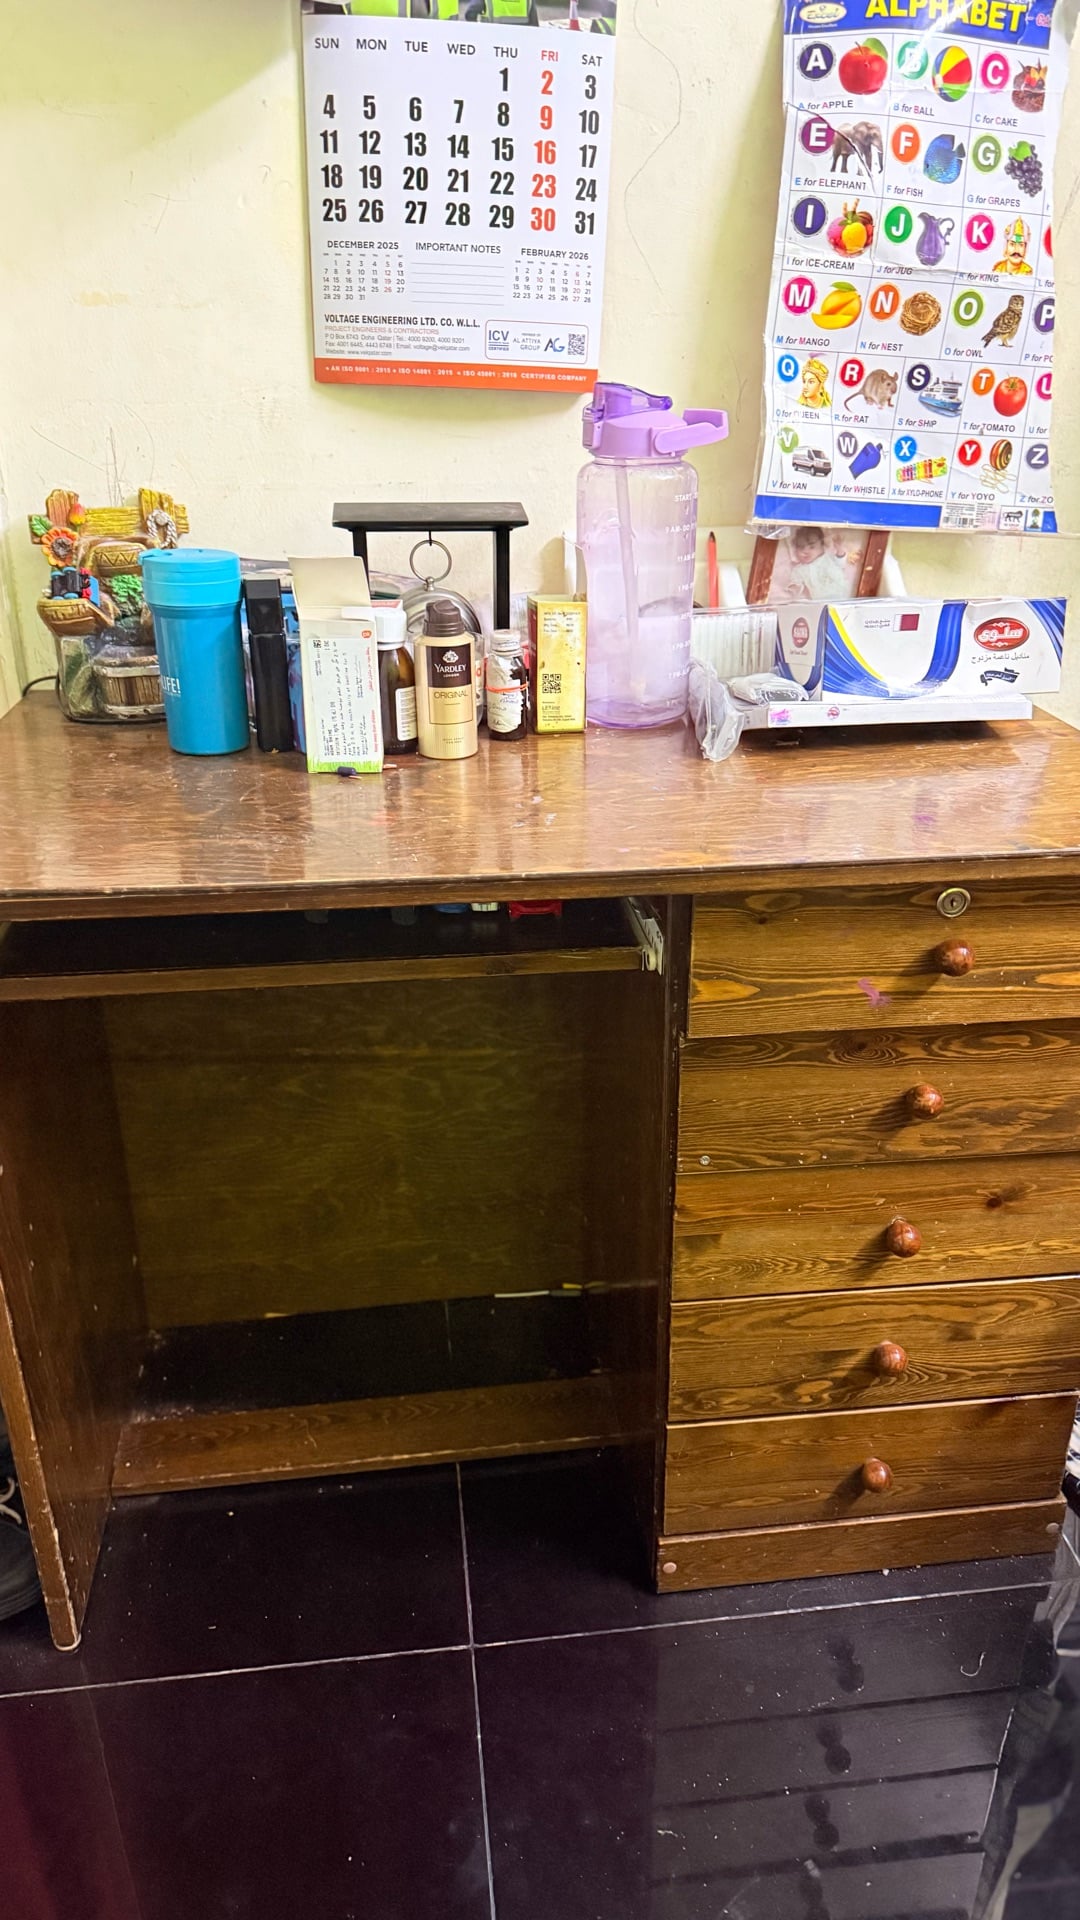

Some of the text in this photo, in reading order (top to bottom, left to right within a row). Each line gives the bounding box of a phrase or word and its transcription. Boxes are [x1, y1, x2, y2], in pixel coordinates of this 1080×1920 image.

[865, 0, 1027, 32] ALPHABET
[314, 38, 602, 67] SUN MON TUE WED THU FRI SAT
[805, 49, 827, 72] A
[986, 61, 1004, 84] C
[499, 68, 596, 100] 1 2 3
[822, 100, 853, 108] APPLE
[901, 105, 912, 113] for
[914, 106, 935, 116] BALL
[323, 94, 599, 135] 4 5 6 7 8 9 10
[975, 114, 1017, 126] C for CAKE
[809, 123, 827, 147] E
[900, 132, 914, 154] F
[320, 130, 597, 168] 11 12 13 14 15 16 17
[977, 142, 996, 165] G
[321, 164, 597, 202] 18 19 20 21 22 23 24
[803, 178, 817, 186] for
[818, 179, 866, 190] ELEPHANT
[906, 187, 923, 197] FISH
[988, 197, 1020, 207] GRAPES
[322, 199, 594, 235] 25 26 27 28 29 30 31
[805, 205, 814, 228] I
[892, 214, 905, 236] J
[971, 221, 990, 244] K
[415, 242, 501, 254] IMPORTANT NOTES
[521, 248, 589, 260] FEBRUARY 2026
[792, 257, 804, 265] for
[805, 259, 855, 270] ICE-CREAM
[896, 267, 913, 275] JUG
[979, 274, 999, 282] KING
[788, 284, 811, 307] M
[874, 292, 893, 313] N
[959, 297, 977, 319] O
[1039, 304, 1055, 325] P
[325, 314, 359, 323] VOLTAGE
[362, 315, 418, 325] ENGINEERING
[420, 318, 438, 326] LTD.
[457, 319, 480, 327] W.L.L.
[488, 330, 509, 341] ICV
[785, 336, 797, 344] for
[799, 337, 830, 346] MANGO
[860, 341, 866, 349] N
[881, 343, 903, 351] NEST
[965, 349, 983, 358] OWL
[781, 358, 795, 377] Q
[844, 363, 859, 382] R
[912, 368, 925, 387] S
[977, 373, 991, 391] T
[841, 414, 852, 422] for
[982, 424, 1015, 432] TOMATO
[1036, 426, 1048, 434] for
[780, 431, 795, 448] V
[838, 436, 856, 454] W
[899, 440, 912, 457] X
[964, 444, 977, 461] Y
[1031, 449, 1046, 464] Z
[779, 481, 791, 489] for
[792, 482, 807, 490] VAN
[854, 486, 886, 494] WHISTLE
[971, 493, 995, 501] YOYO
[434, 663, 466, 673] YARDLEY
